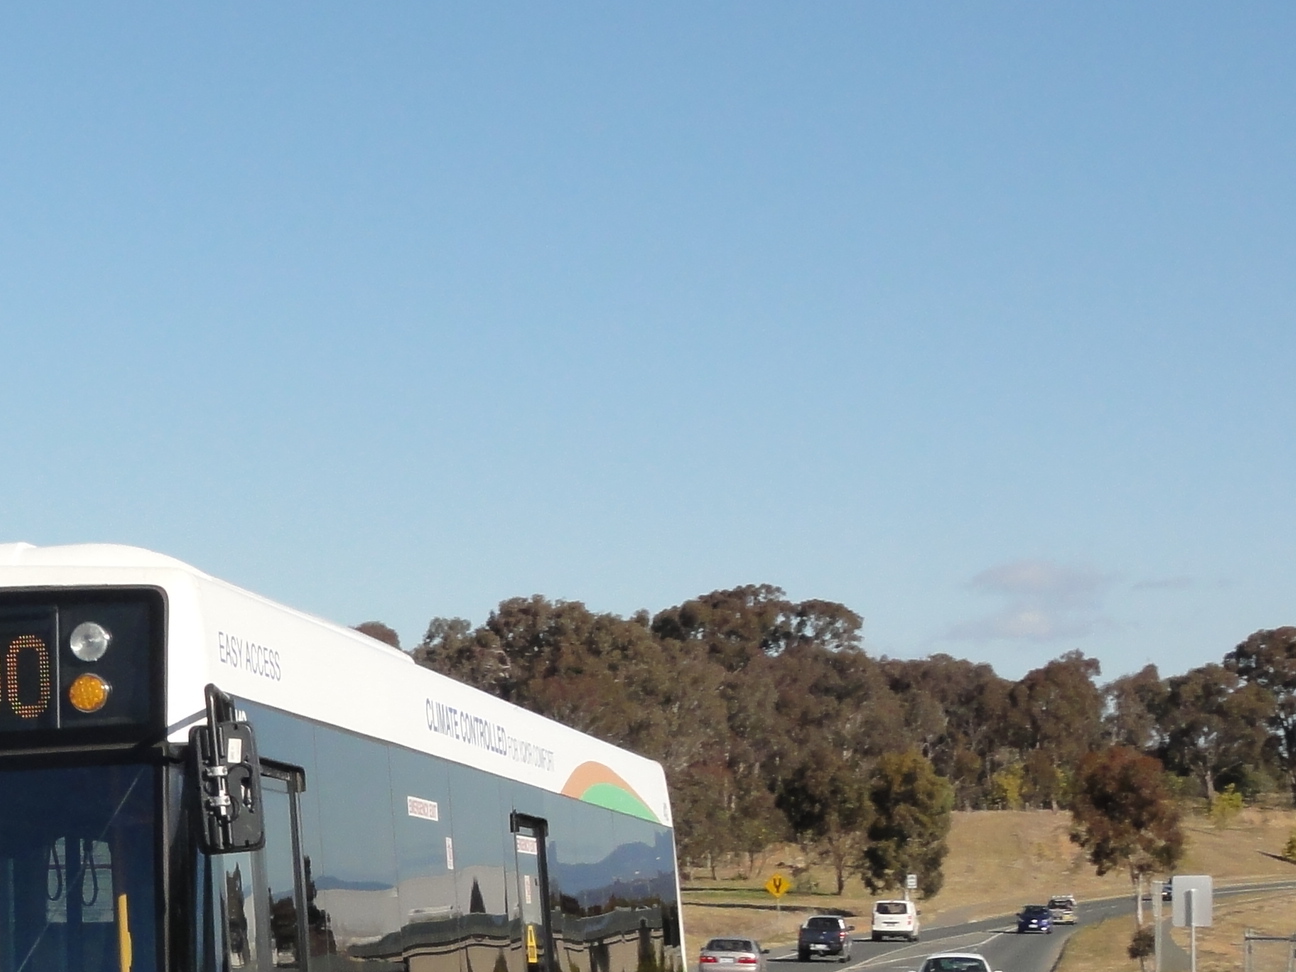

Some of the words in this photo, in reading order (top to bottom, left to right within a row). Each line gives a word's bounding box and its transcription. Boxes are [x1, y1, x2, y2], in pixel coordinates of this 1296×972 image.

[218, 631, 243, 669] EASY
[245, 641, 281, 682] ACCESS
[426, 698, 460, 740] CLIMATE
[460, 710, 508, 756] CONTROLLED
